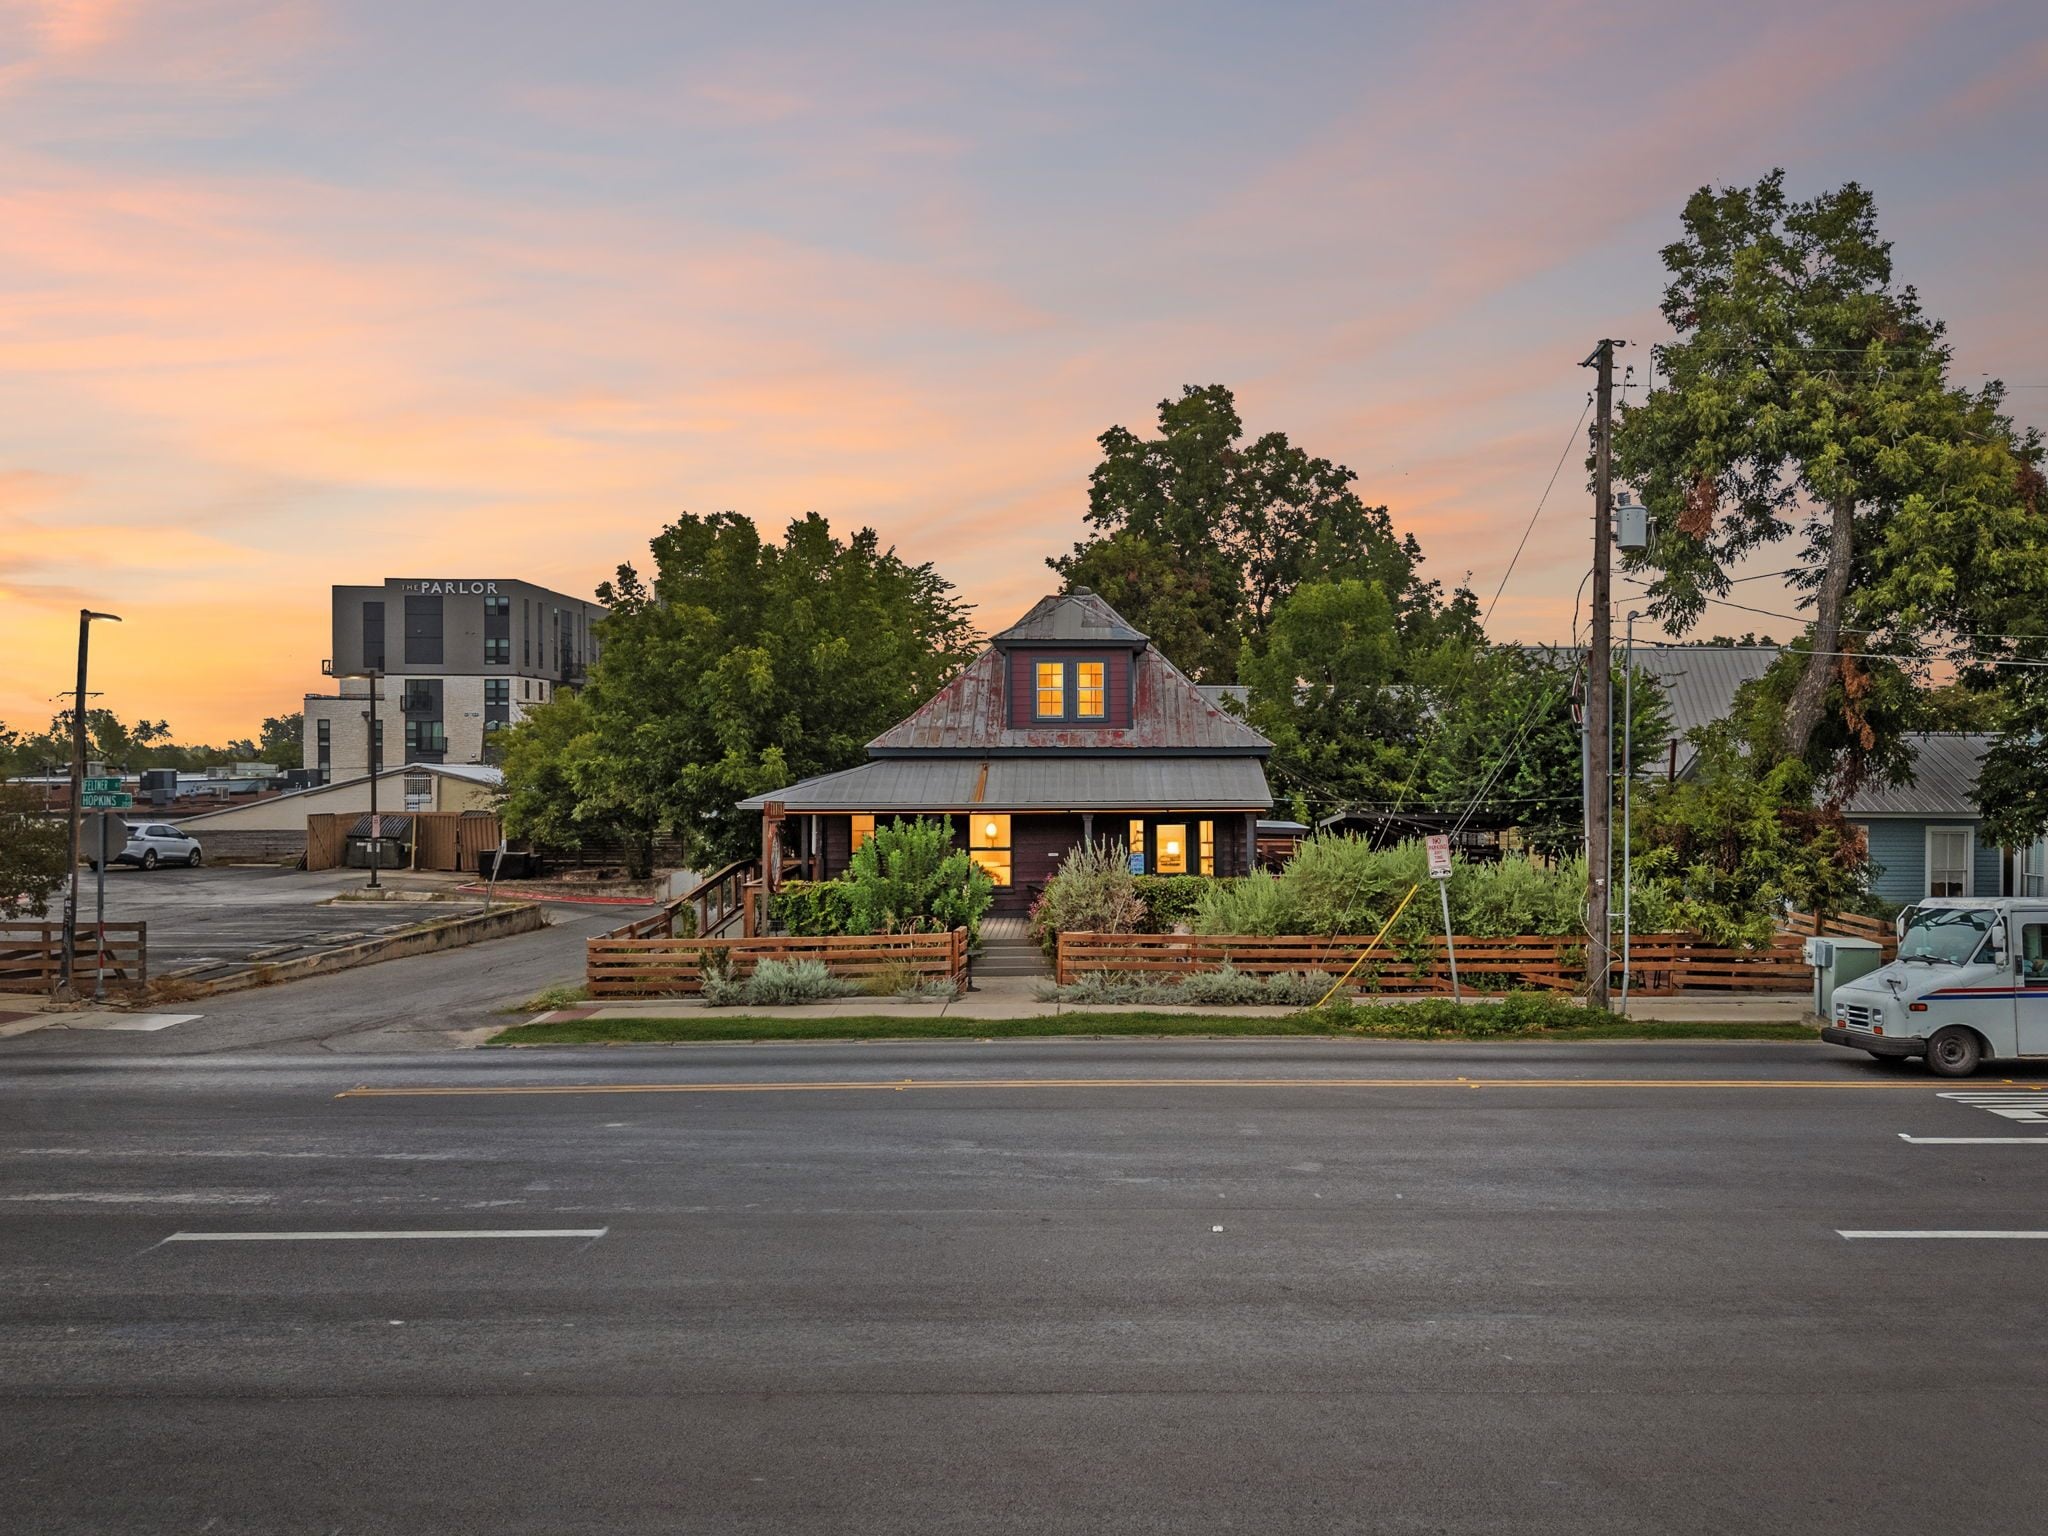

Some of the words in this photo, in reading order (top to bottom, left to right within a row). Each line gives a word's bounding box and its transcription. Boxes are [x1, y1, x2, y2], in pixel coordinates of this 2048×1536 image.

[422, 582, 498, 594] PARLOR
[84, 780, 108, 791] FELTNER
[82, 796, 116, 806] HOPKINS
